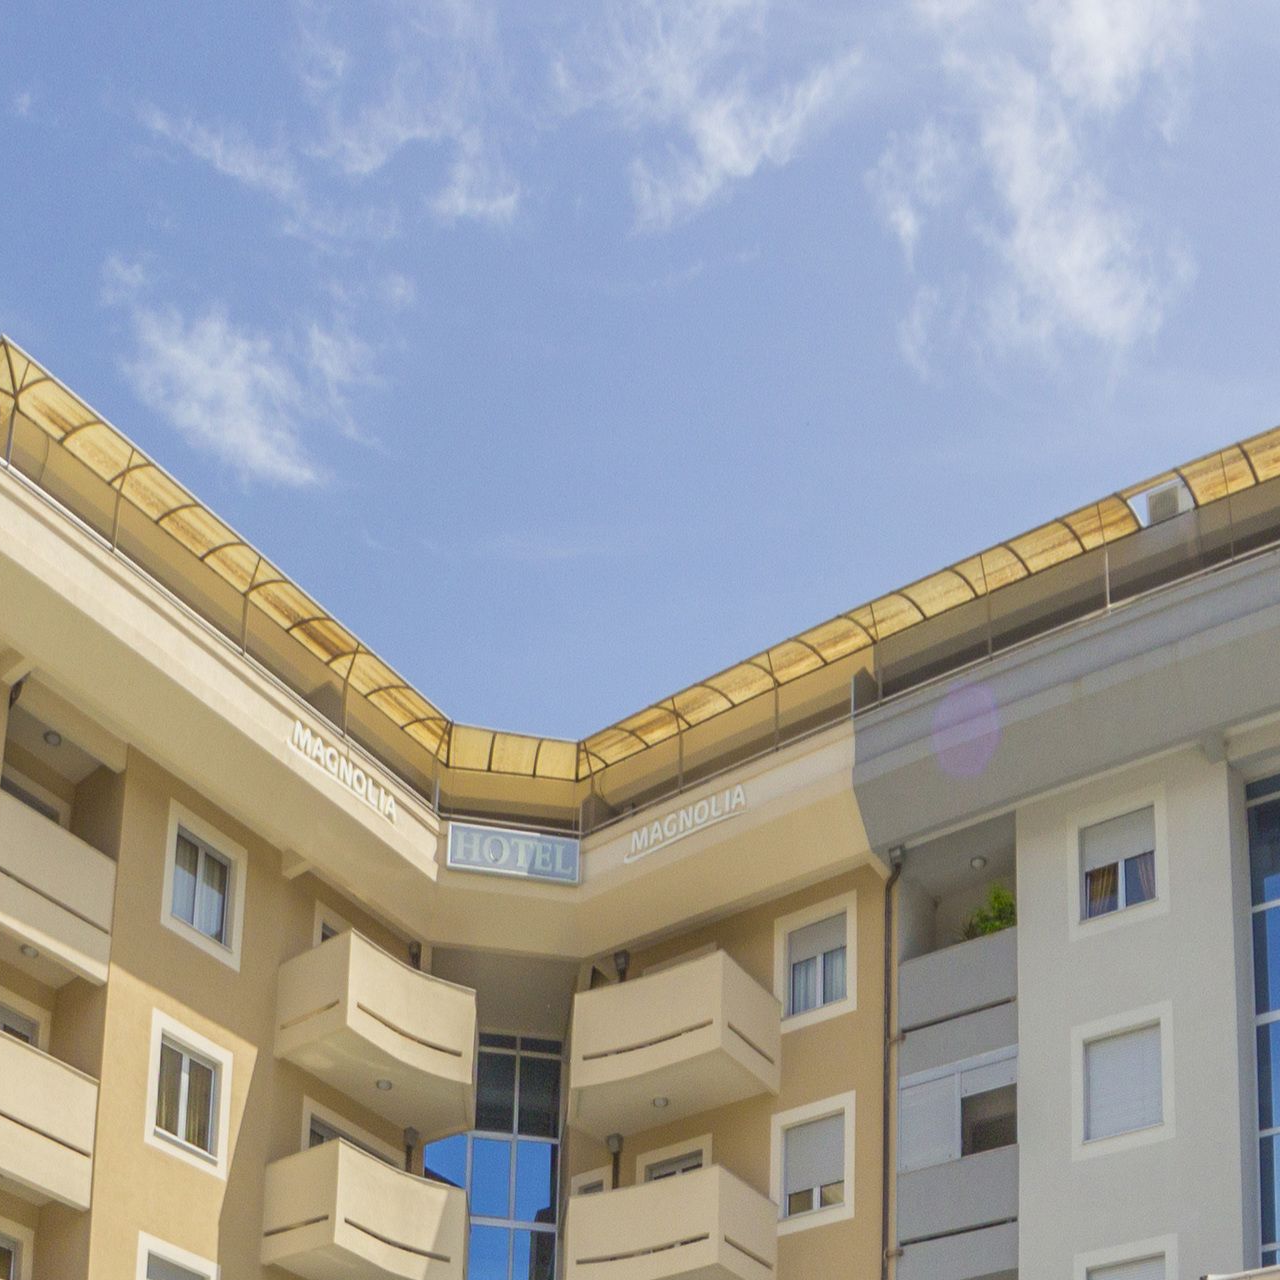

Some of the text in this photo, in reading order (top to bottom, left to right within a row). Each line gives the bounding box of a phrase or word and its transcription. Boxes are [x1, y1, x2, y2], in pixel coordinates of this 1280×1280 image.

[293, 719, 396, 824] MAGNOLIA
[453, 830, 577, 874] HOTEL
[630, 784, 747, 853] MAGNOLIA
